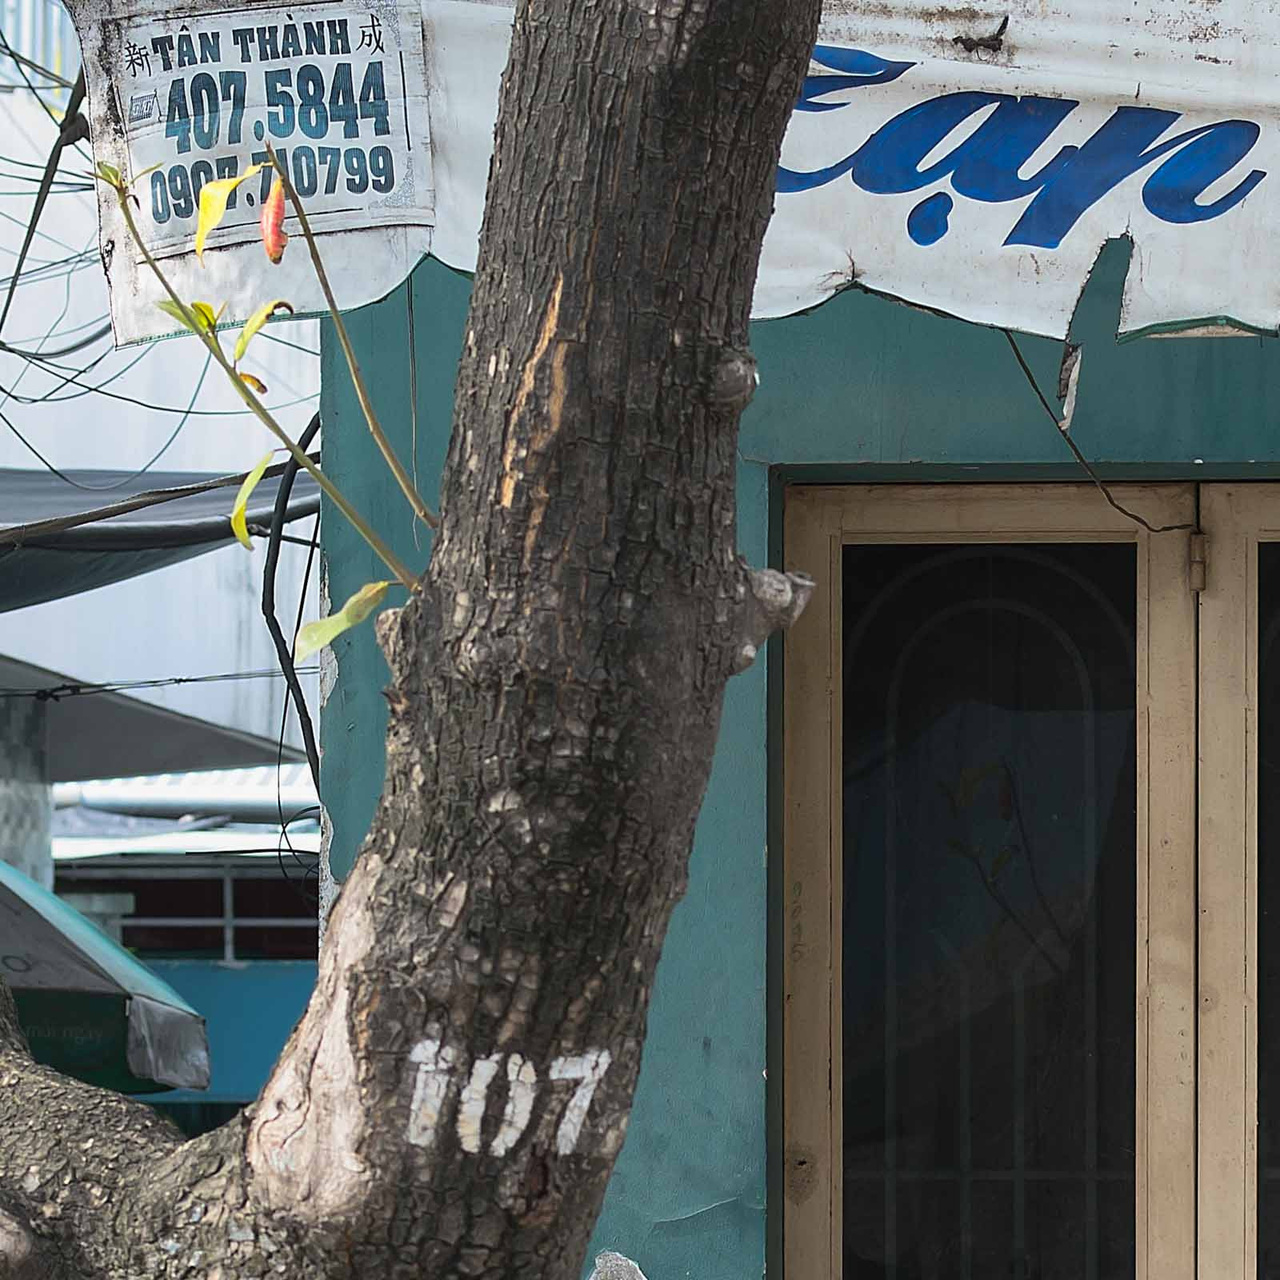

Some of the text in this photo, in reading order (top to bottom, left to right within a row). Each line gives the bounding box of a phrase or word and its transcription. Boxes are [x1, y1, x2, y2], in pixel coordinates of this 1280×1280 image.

[124, 14, 386, 77] 新 TÂN THÀNH 成
[165, 61, 390, 154] 407.5844
[408, 1038, 612, 1157] 107
